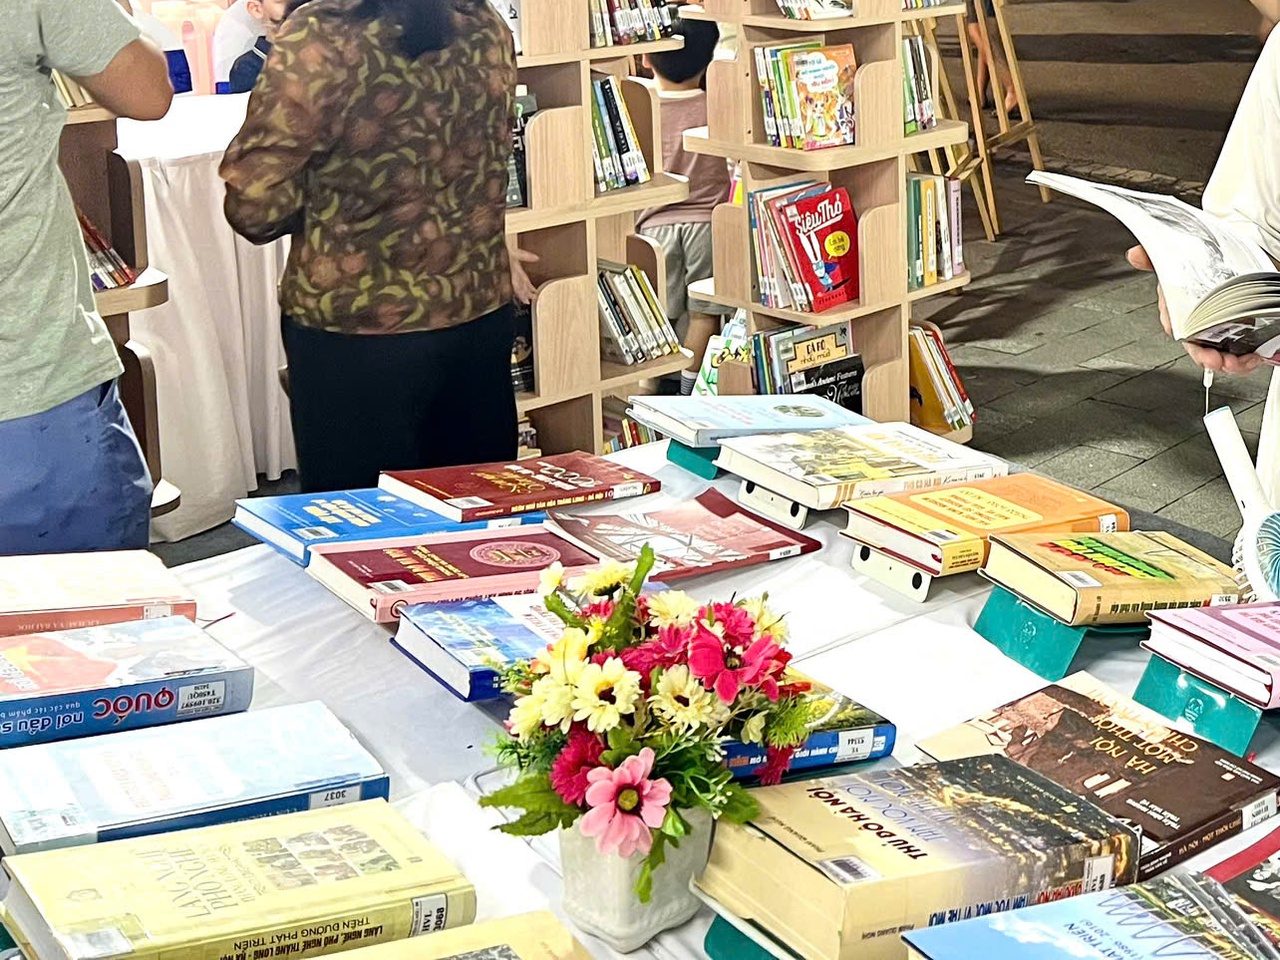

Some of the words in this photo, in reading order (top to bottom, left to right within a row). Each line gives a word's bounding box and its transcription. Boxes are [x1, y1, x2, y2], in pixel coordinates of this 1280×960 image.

[795, 212, 822, 236] Siêu
[817, 193, 842, 222] Thỏ
[10, 706, 31, 719] phẩm
[33, 705, 46, 715] tác
[48, 703, 62, 713] các
[65, 699, 80, 708] qua
[91, 686, 174, 727] QUỐC
[17, 715, 51, 738] đầu
[55, 711, 83, 729] nơi
[1098, 717, 1139, 744] THỜI
[1088, 734, 1124, 757] NỘI
[1141, 739, 1182, 765] MỘT
[1124, 753, 1157, 774] HÀ
[324, 789, 346, 801] 3037
[806, 787, 846, 806] NỘI
[833, 805, 870, 823] HÀ
[858, 822, 896, 839] ĐÔ
[882, 837, 928, 860] THỦ
[300, 921, 339, 941] ĐƯỜNG
[342, 915, 369, 932] TRÊN
[363, 924, 382, 941] LÀNG
[270, 930, 297, 946] PHÁT
[301, 936, 322, 952] NGHỀ
[323, 933, 338, 948] PHỐ
[1063, 922, 1101, 948] TRIỂN
[233, 936, 266, 954] TRIỂN
[253, 946, 272, 960] LONG
[273, 940, 299, 957] THĂNG
